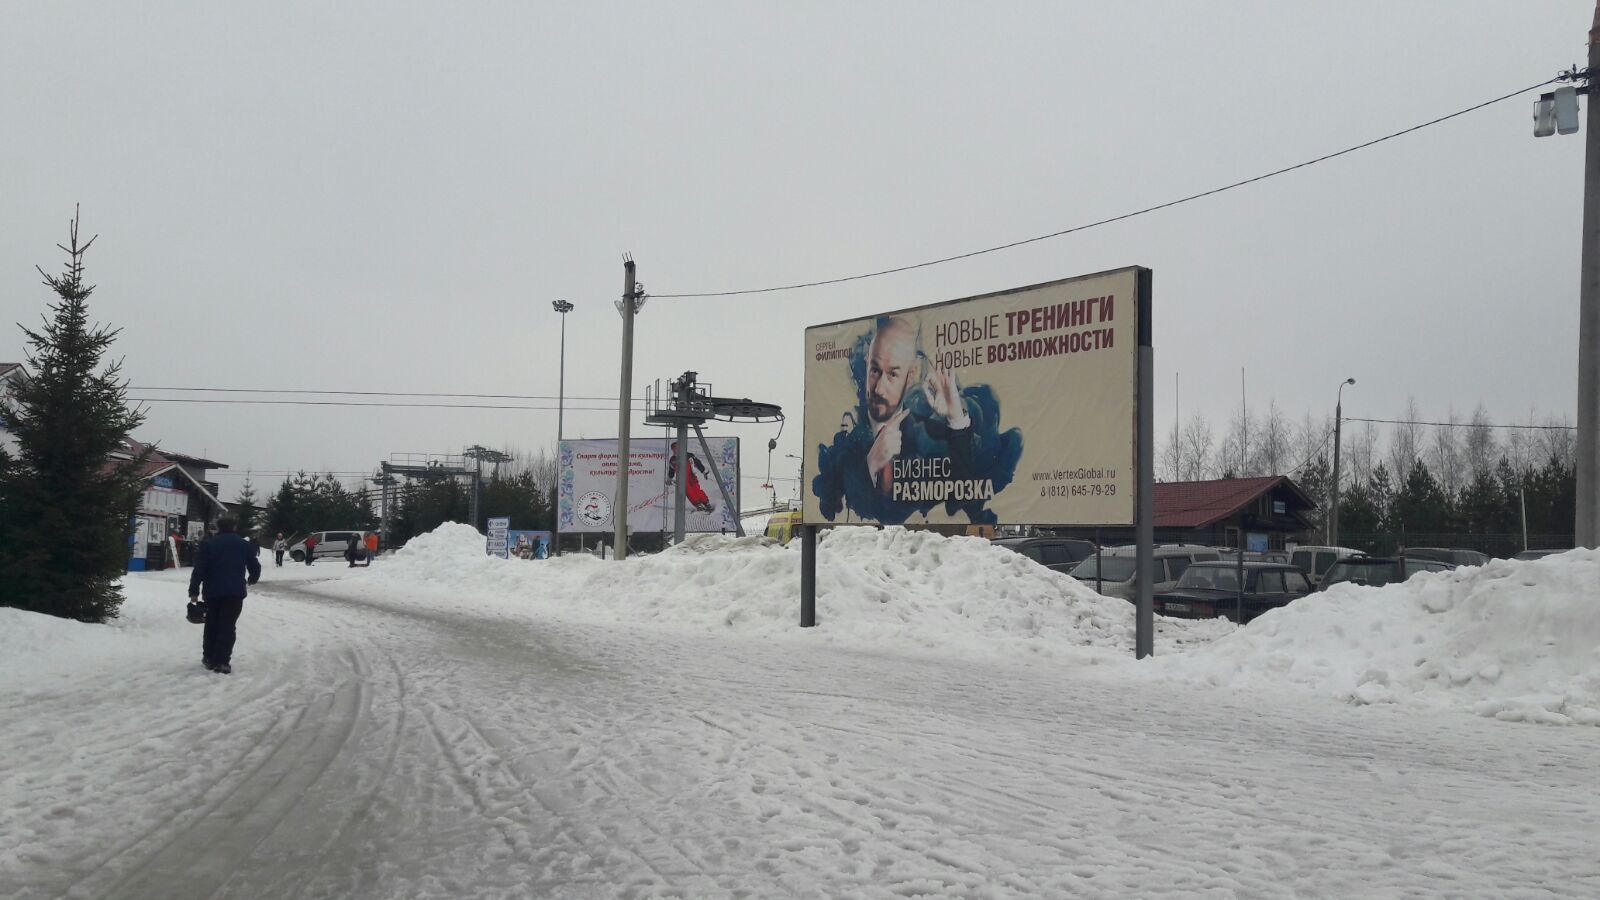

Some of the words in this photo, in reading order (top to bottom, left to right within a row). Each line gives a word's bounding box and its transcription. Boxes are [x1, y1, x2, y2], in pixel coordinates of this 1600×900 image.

[936, 314, 999, 348] НОВЫЕ
[1005, 295, 1115, 337] ТРЕНИНГИ
[935, 346, 983, 371] НОВЫЕ
[987, 328, 1115, 364] ВОЗМОЖНОСТИ
[893, 457, 951, 479] БИЗНЕС
[1032, 467, 1116, 481] www.VertexGlobal.ru
[892, 479, 995, 501] РАЗМОРОЗКА
[1040, 486, 1046, 497] 8
[1048, 485, 1069, 500] (812)
[1071, 484, 1116, 497] 645-79-29
